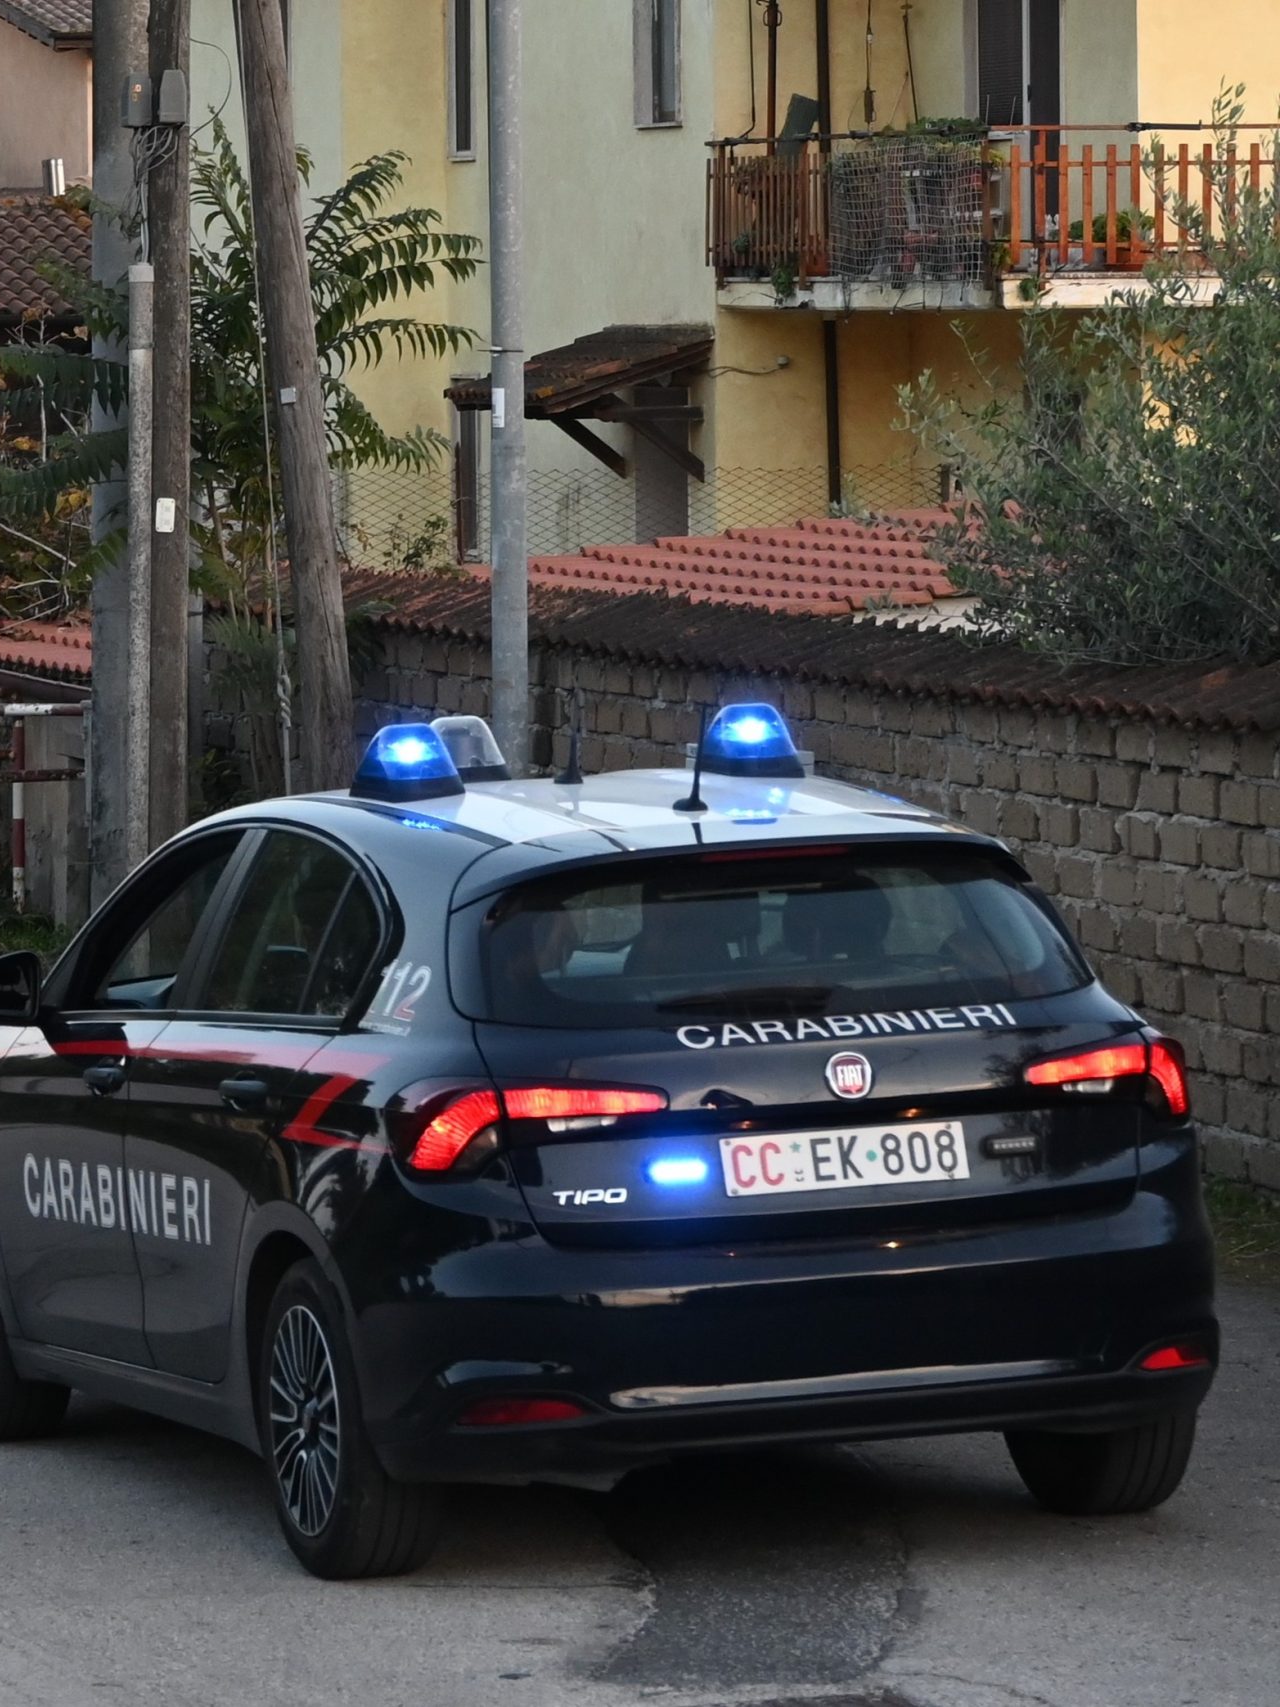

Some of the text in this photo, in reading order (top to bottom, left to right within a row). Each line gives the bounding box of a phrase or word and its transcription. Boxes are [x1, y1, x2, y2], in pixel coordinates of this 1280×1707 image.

[676, 1003, 1017, 1049] CARABINIERI
[836, 1064, 863, 1087] FIAT
[731, 1130, 958, 1188] CC EK 808
[23, 1153, 212, 1245] CARABINIERI
[552, 1188, 628, 1206] TIPO
